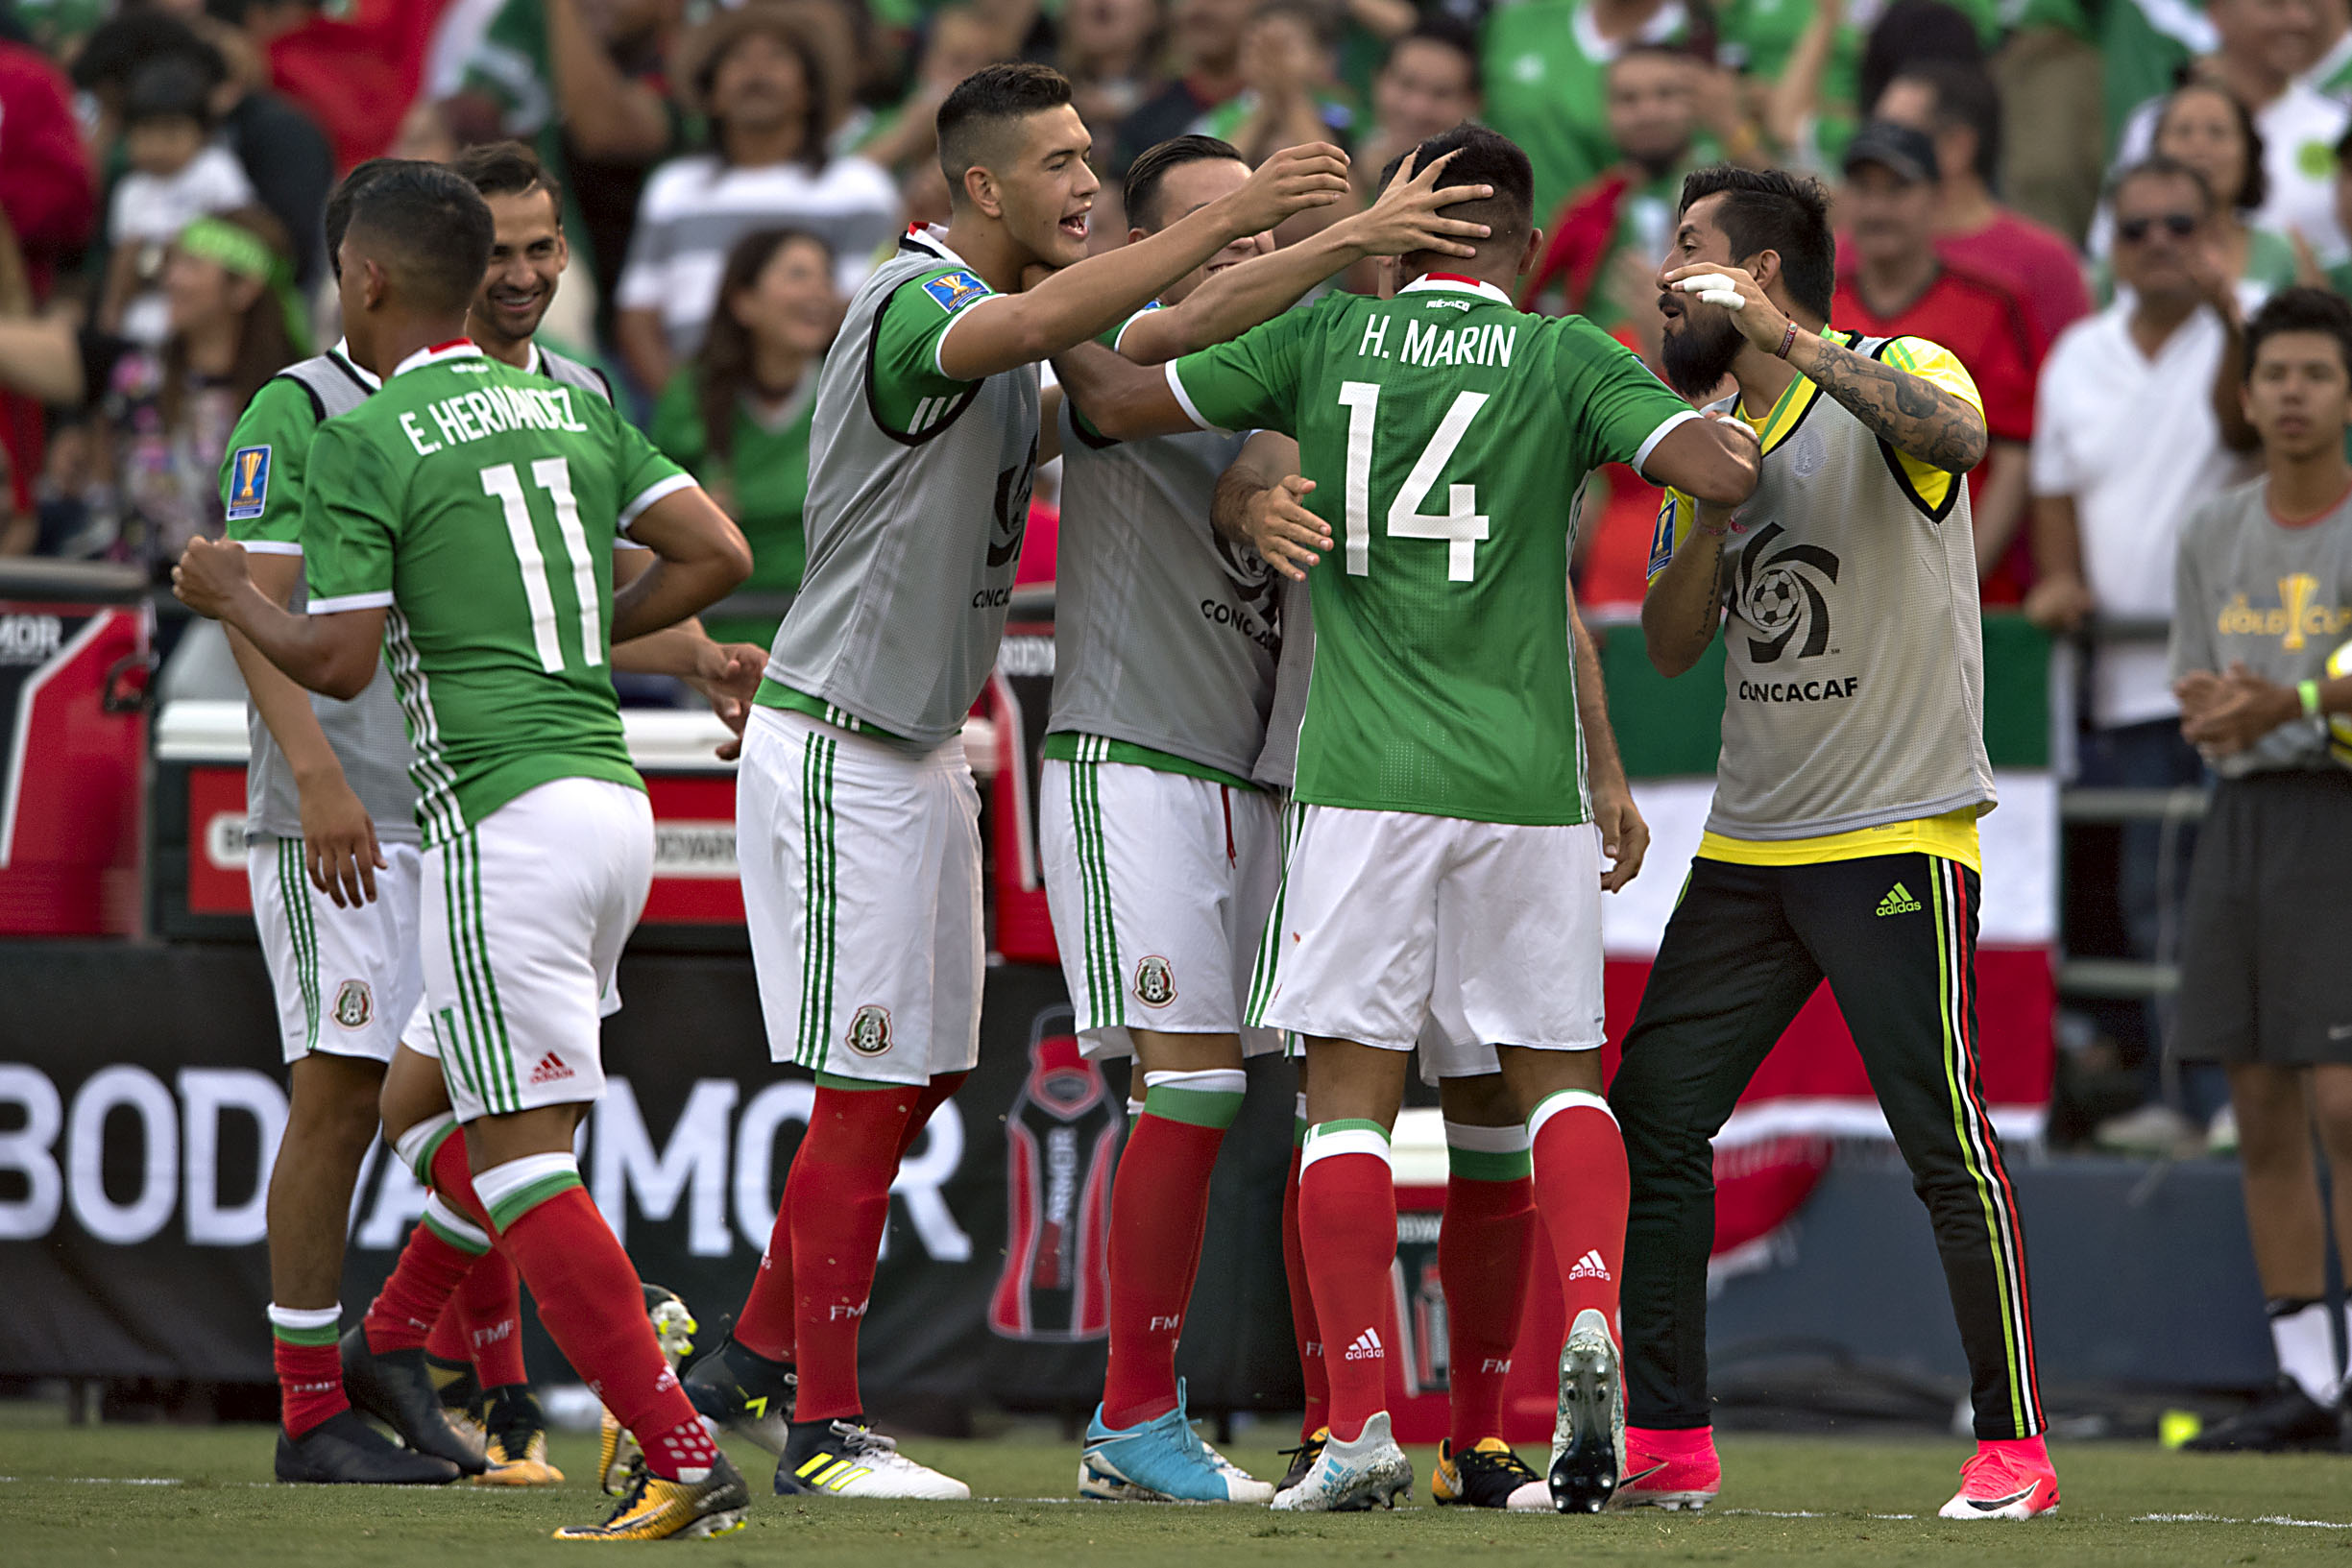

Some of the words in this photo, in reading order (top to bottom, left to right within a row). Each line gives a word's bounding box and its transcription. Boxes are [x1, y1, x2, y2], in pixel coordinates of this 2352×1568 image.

[1358, 313, 1391, 359] H.
[1399, 319, 1517, 368] MARIN
[399, 411, 443, 456] E.
[1338, 380, 1491, 582] 14
[479, 456, 603, 674] 11
[1876, 901, 1922, 917] adidas
[1568, 1266, 1611, 1282] adidas
